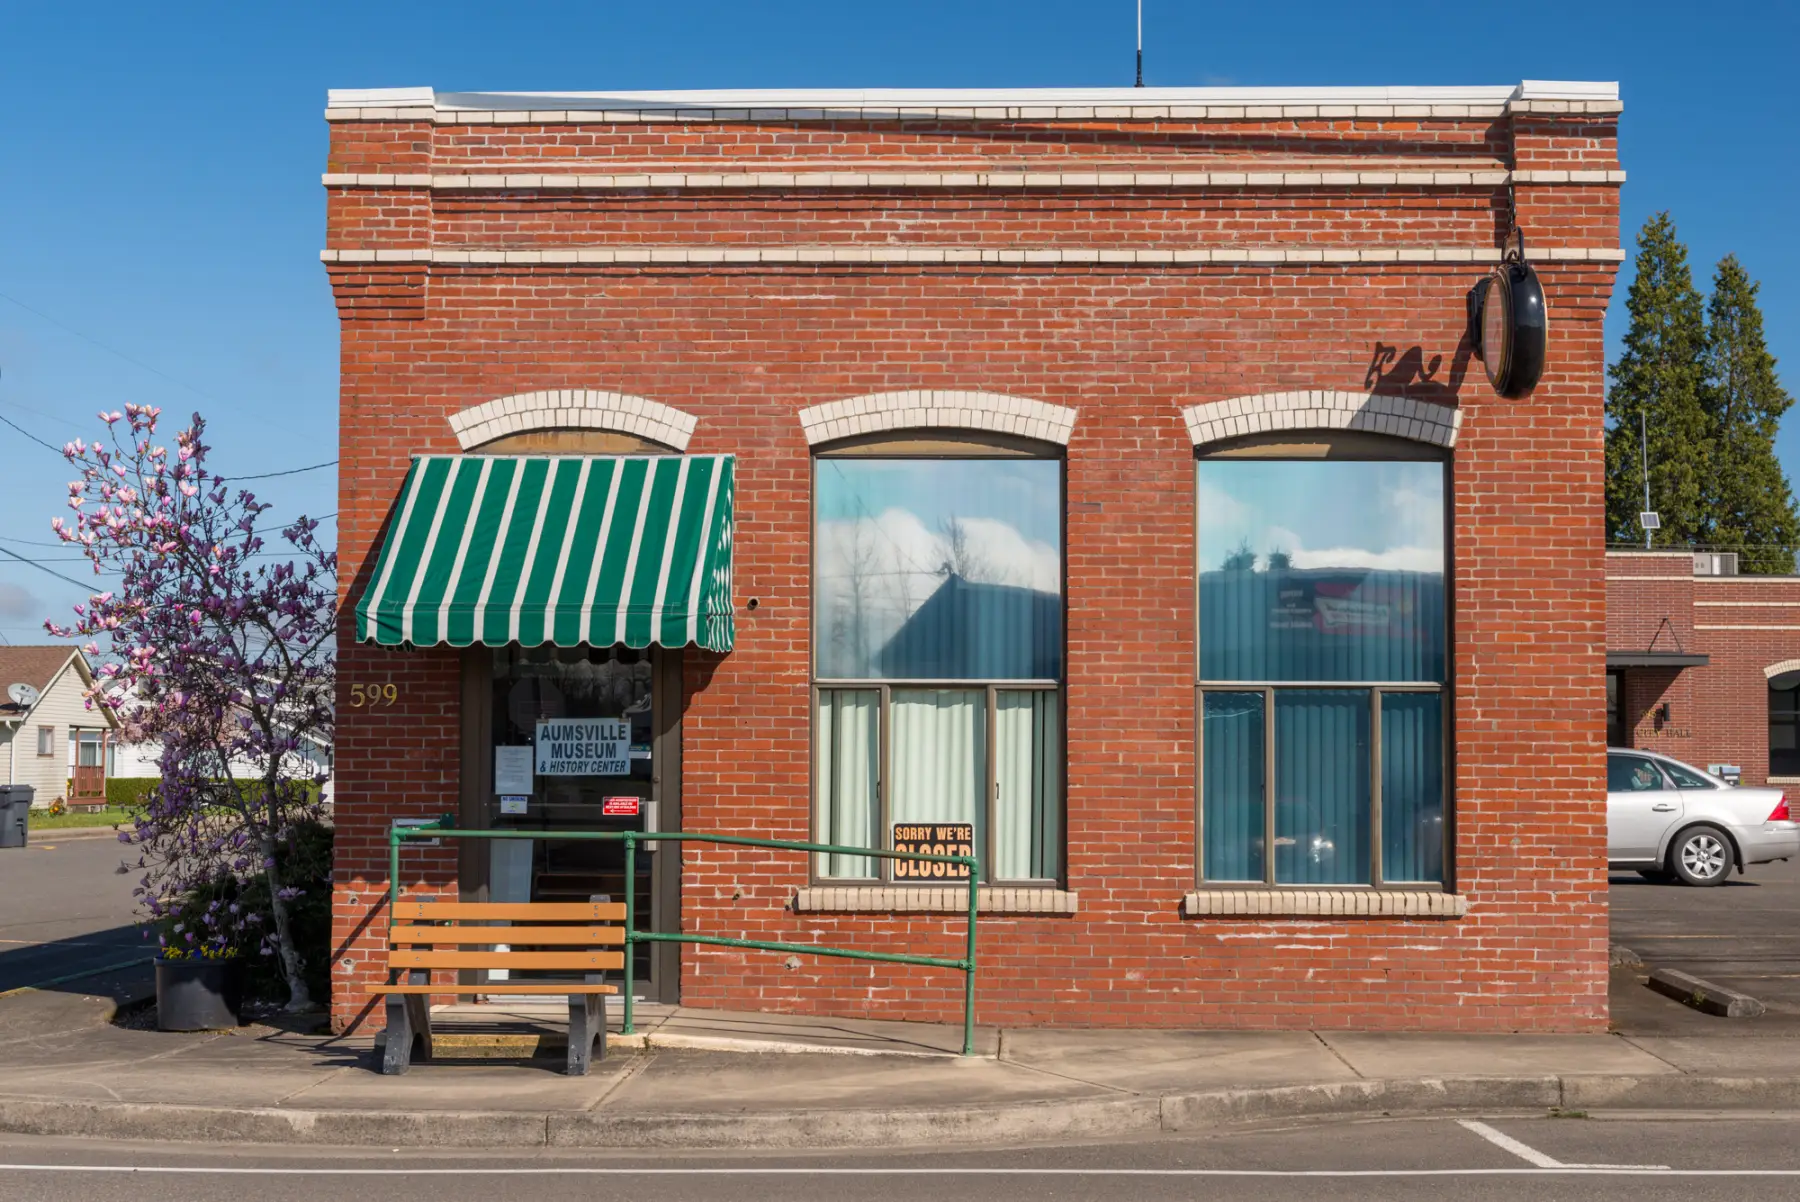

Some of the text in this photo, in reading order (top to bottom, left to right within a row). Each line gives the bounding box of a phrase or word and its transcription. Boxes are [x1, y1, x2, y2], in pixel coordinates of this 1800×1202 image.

[350, 683, 398, 708] 599
[540, 724, 627, 741] AUMSVILLE
[551, 742, 617, 759] MUSEUM
[539, 760, 626, 773] & HISTORY CENTER
[895, 827, 972, 840] SORRY WE'RE
[895, 843, 972, 877] CLOSED
